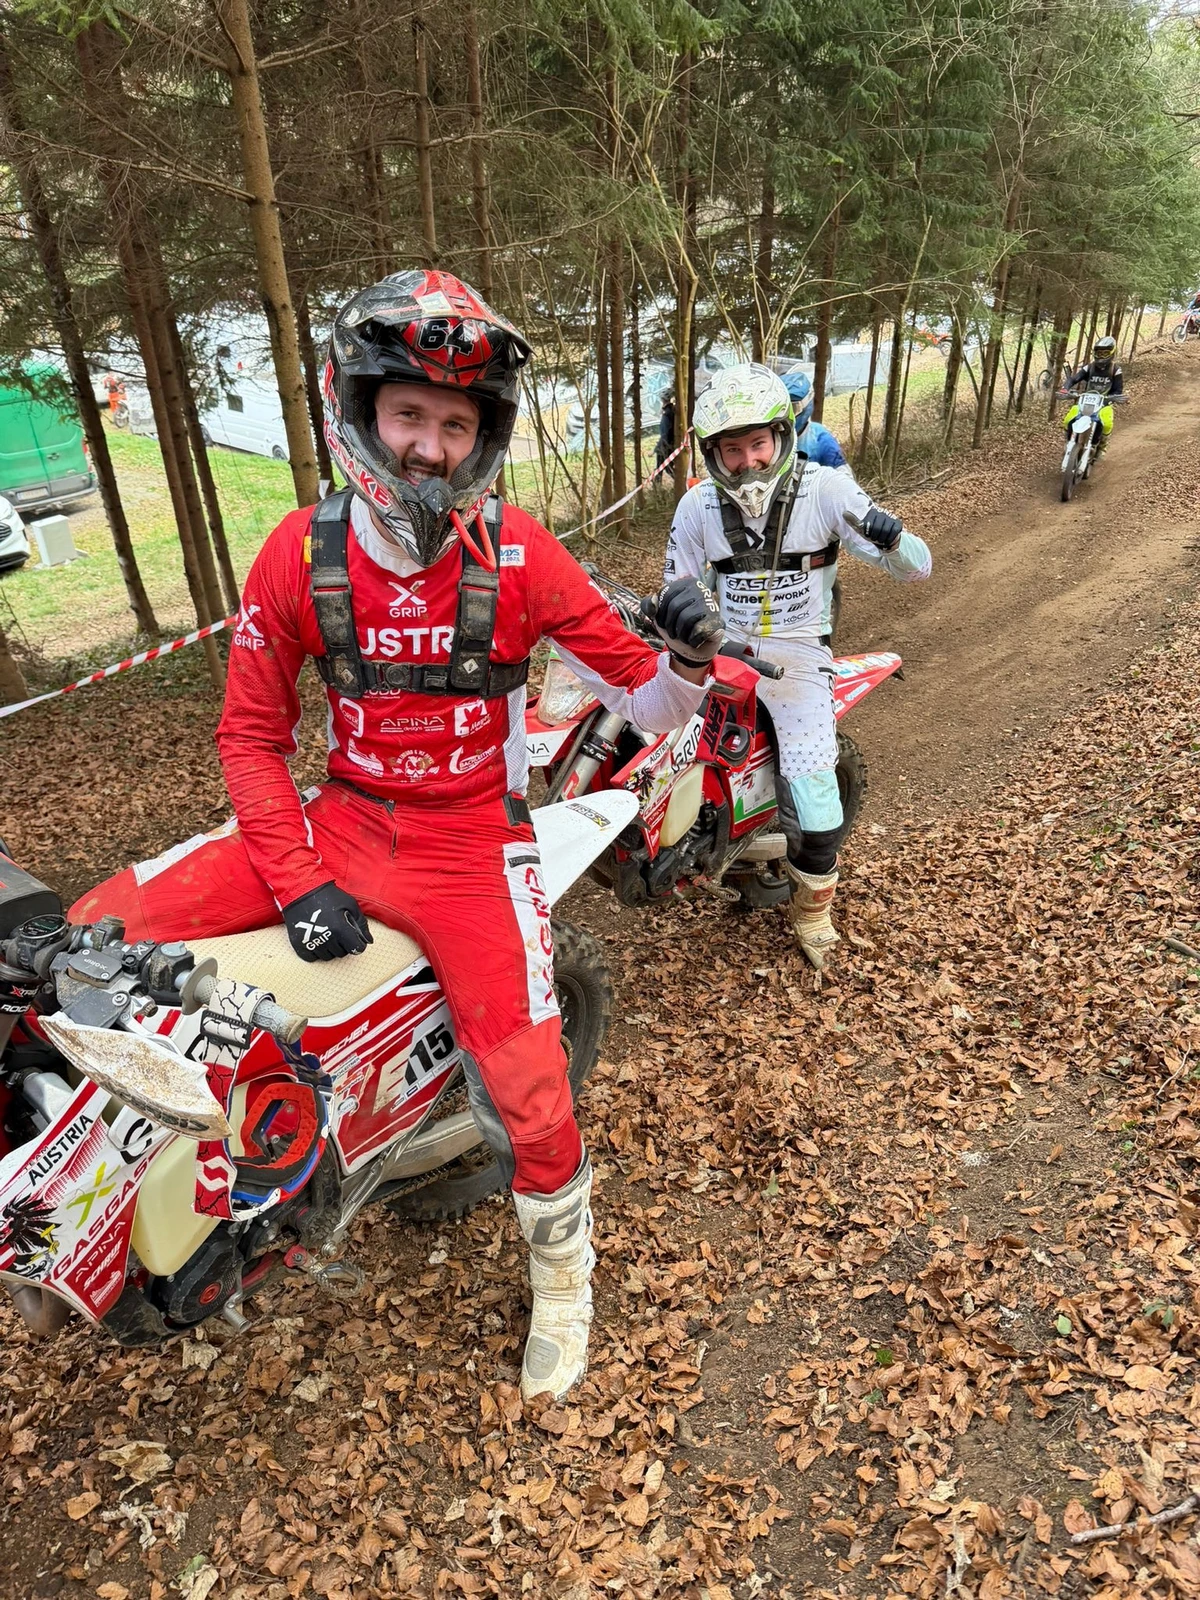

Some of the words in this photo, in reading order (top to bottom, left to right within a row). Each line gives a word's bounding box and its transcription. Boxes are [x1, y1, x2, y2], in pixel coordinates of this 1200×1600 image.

[726, 572, 809, 591] GASGAS
[725, 591, 764, 604] auner
[388, 605, 428, 618] GRIP
[359, 625, 497, 658] USTR
[380, 715, 445, 727] APINA
[648, 741, 670, 765] AUSTRIA
[304, 930, 333, 952] GRIP
[28, 1114, 94, 1187] AUSTRIA
[52, 1156, 151, 1281] GASGAS
[74, 1221, 126, 1284] APINA
